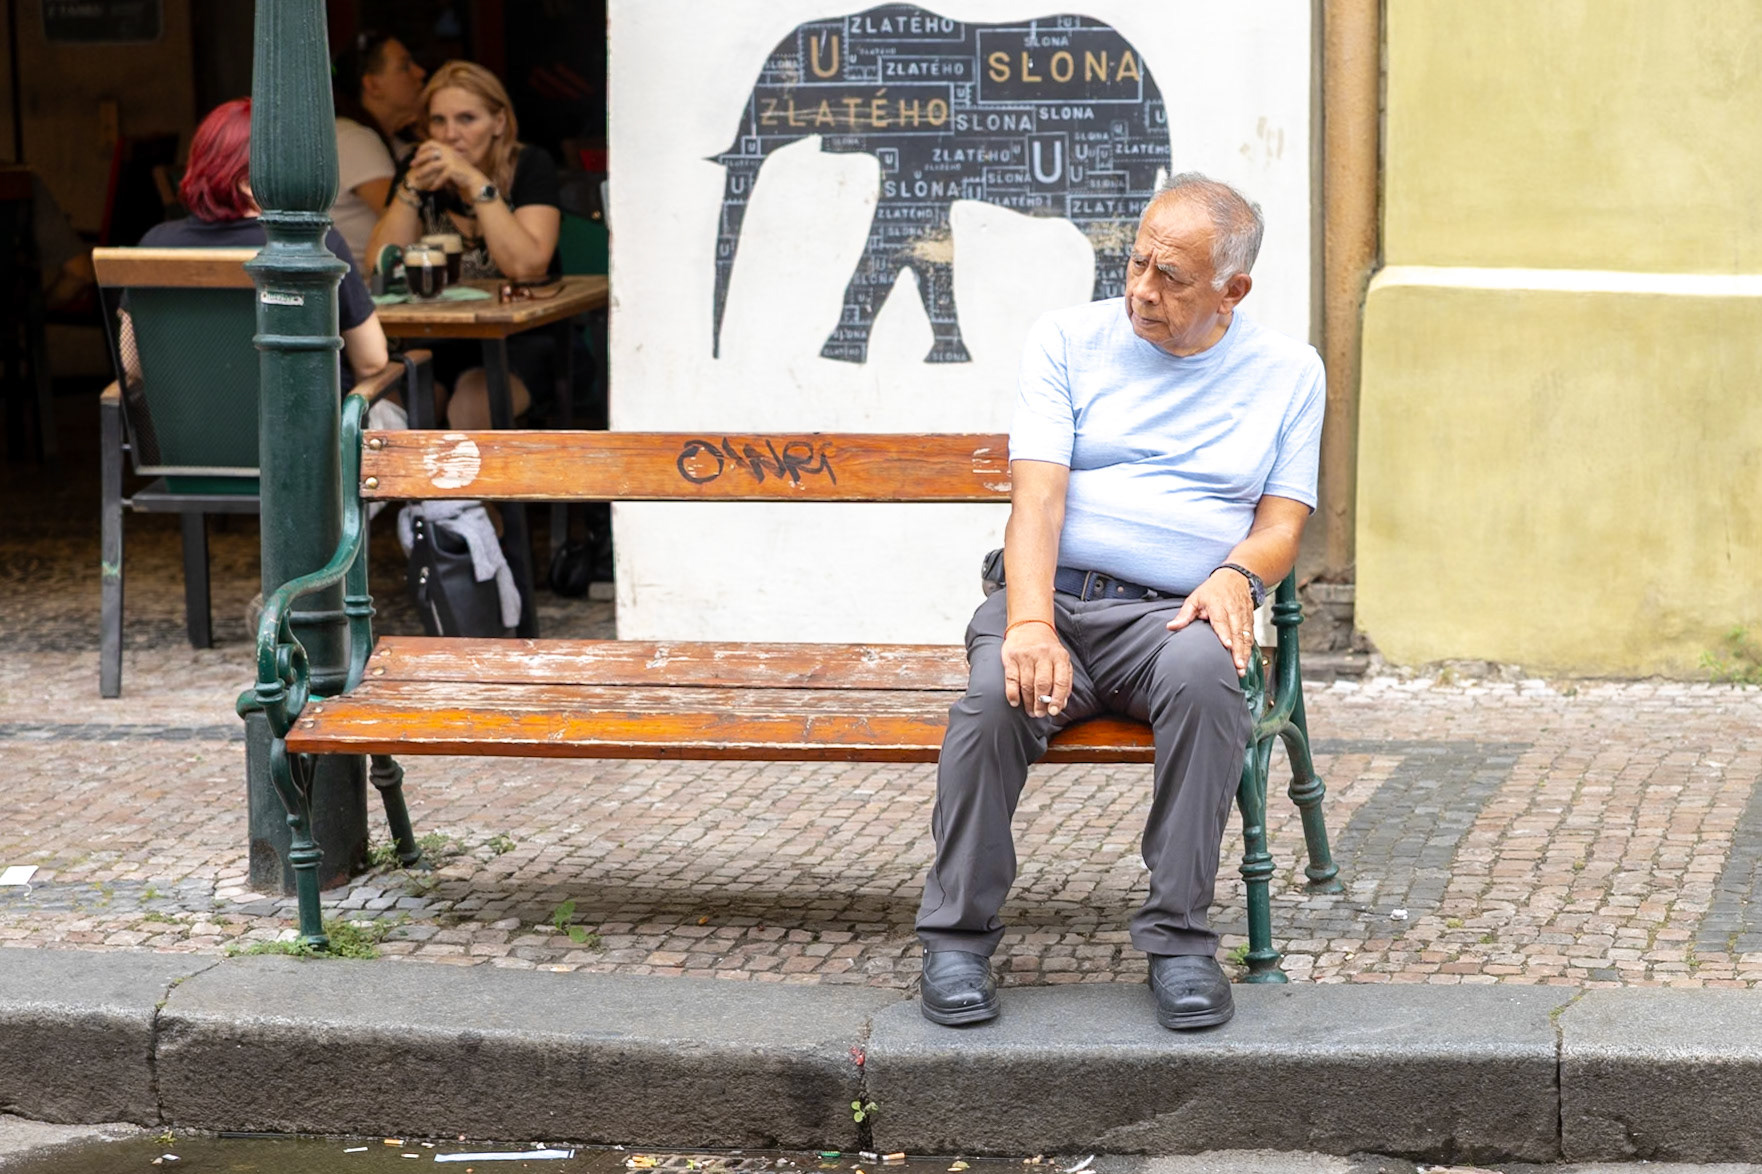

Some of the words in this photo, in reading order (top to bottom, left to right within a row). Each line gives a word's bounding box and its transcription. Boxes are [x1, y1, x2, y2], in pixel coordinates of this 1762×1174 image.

[850, 11, 954, 34] ZLATÉHO
[1024, 36, 1069, 47] SLONA
[810, 35, 839, 78] U
[849, 54, 858, 64] U
[886, 58, 964, 76] ZLATÉHO
[988, 51, 1140, 83] SLONA
[956, 88, 966, 98] U
[761, 88, 948, 127] ZLATÉHO
[1039, 106, 1095, 120] SLONA
[956, 114, 1032, 131] SLONA
[884, 153, 894, 165] U
[932, 144, 1011, 162] ZLATÉHO
[1075, 143, 1089, 160] U
[1033, 140, 1062, 184] U
[914, 171, 922, 180] U
[987, 172, 1033, 184] SLONA
[1070, 165, 1083, 183] U
[731, 176, 744, 194] U
[884, 181, 960, 198] SLONA
[719, 243, 730, 256] U
